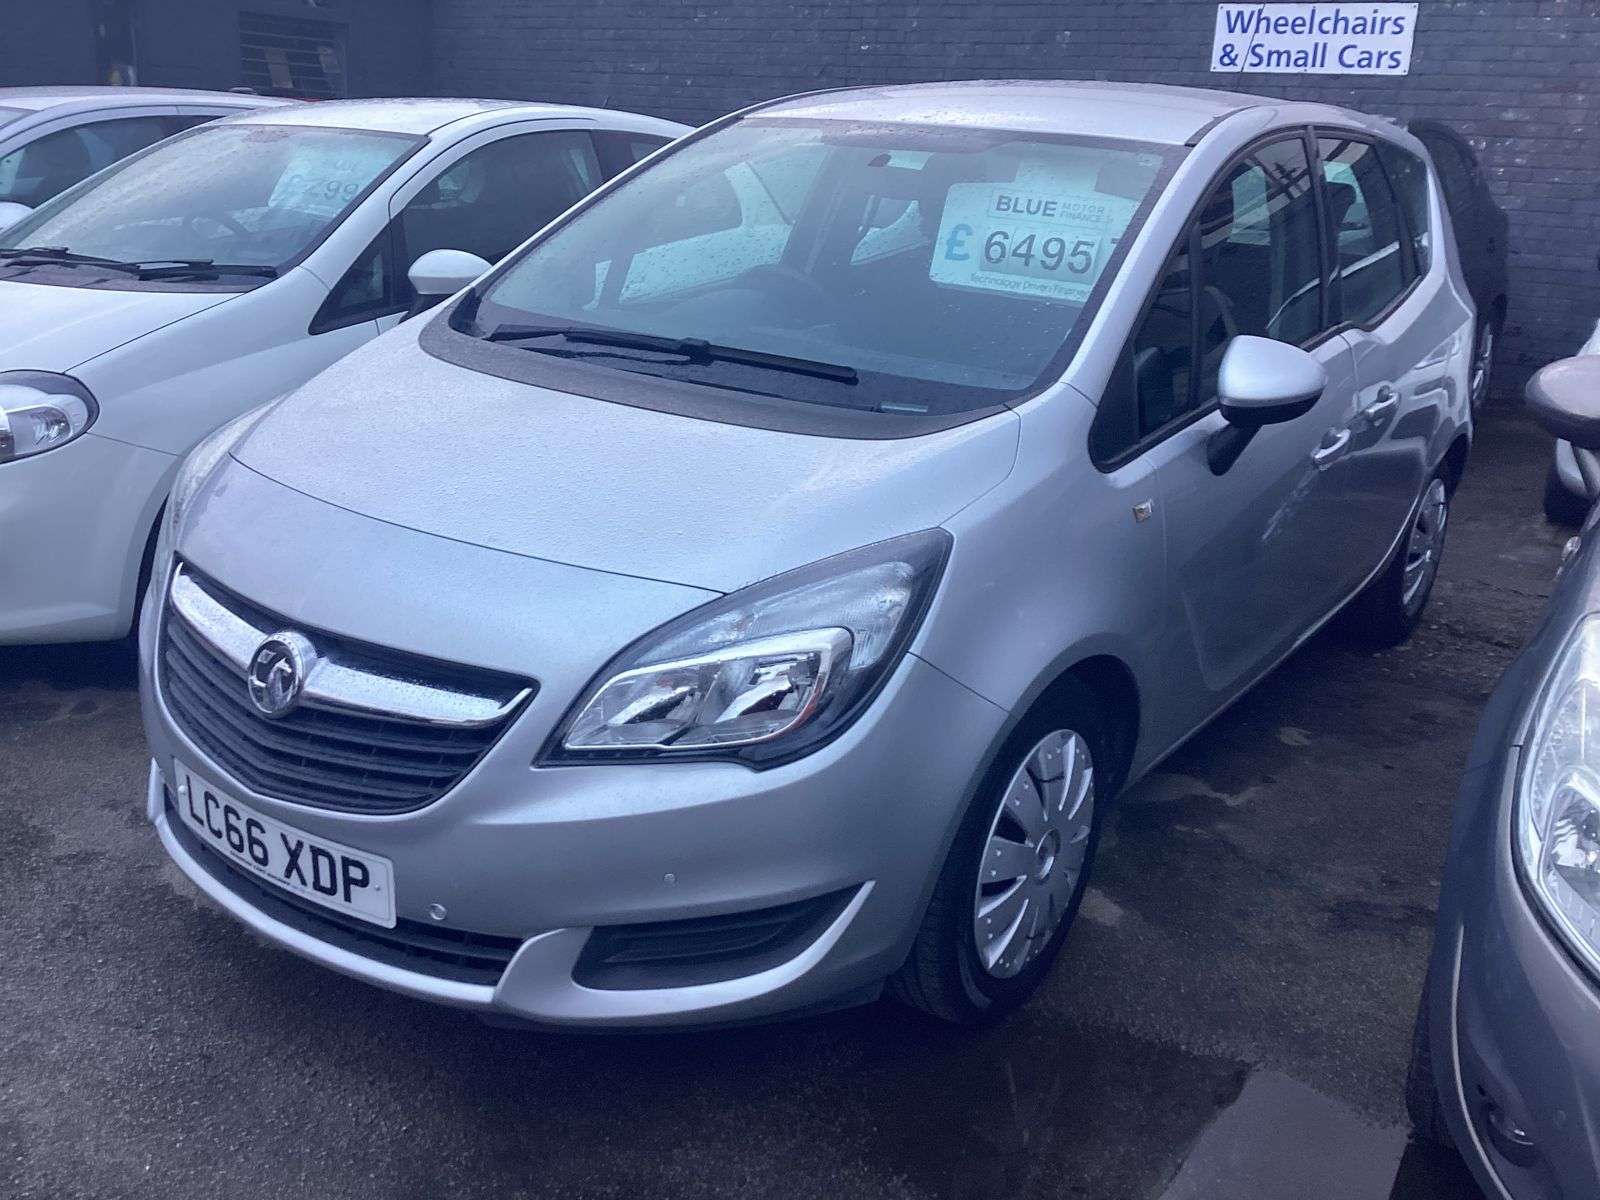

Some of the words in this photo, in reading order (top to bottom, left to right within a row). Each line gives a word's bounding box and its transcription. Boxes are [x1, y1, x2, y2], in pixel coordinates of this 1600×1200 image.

[1225, 8, 1406, 35] Wheelchairs
[1218, 43, 1239, 67] &
[1249, 42, 1328, 68] Small
[1338, 44, 1402, 69] Cars
[996, 195, 1058, 217] BLUE
[1061, 202, 1105, 214] MOTOR
[944, 223, 973, 261] £
[984, 230, 1095, 274] 6495
[186, 774, 269, 867] LC66
[280, 831, 370, 903] XDP
